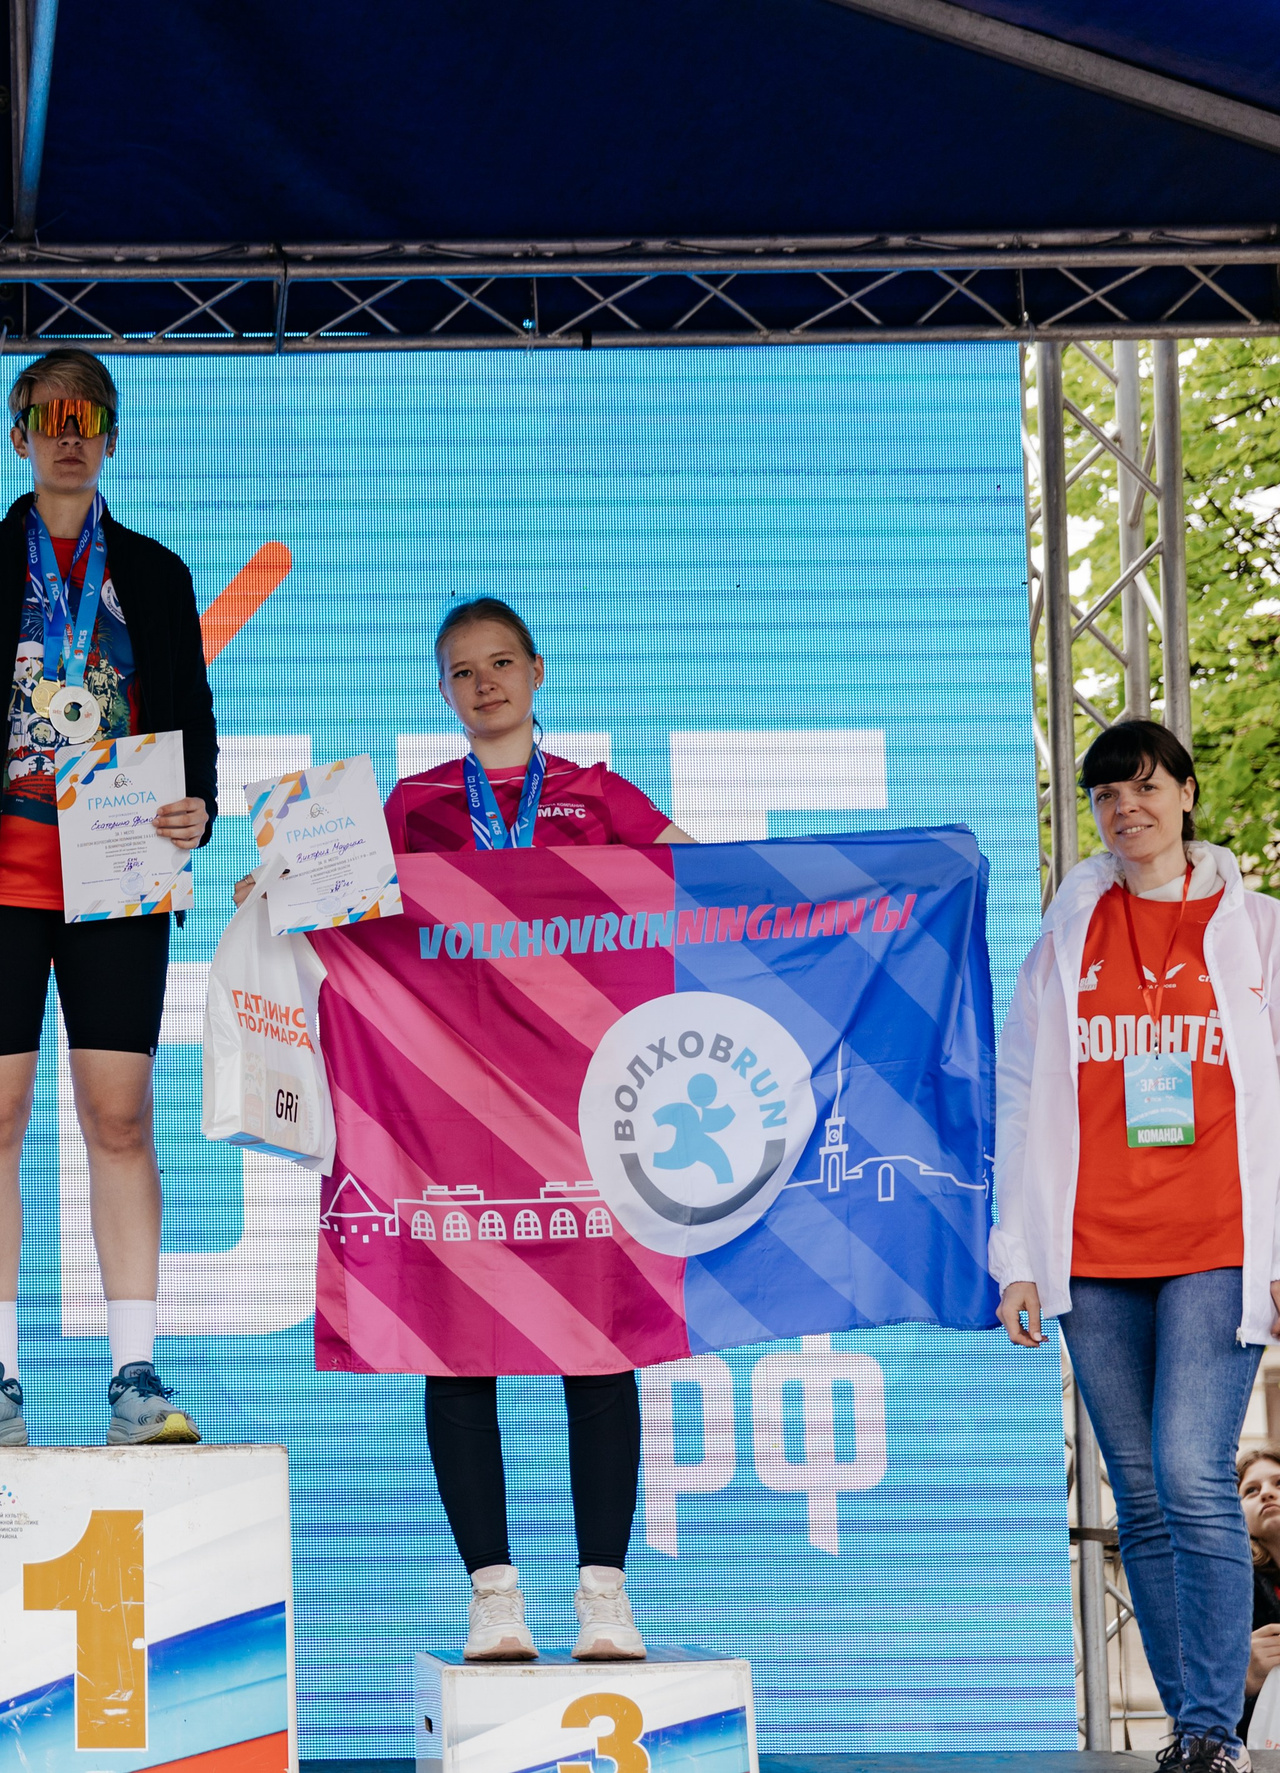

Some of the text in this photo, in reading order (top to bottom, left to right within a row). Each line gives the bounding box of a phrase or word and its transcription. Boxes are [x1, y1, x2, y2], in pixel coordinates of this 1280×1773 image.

[29, 537, 39, 564] СПОРТ
[76, 629, 88, 649] ПСБ
[88, 790, 157, 810] ГРАМОТА
[469, 784, 480, 808] СПОРТ
[537, 807, 586, 819] МАРС
[286, 816, 356, 844] ГРАМОТА
[490, 820, 502, 836] ПСБ
[276, 1088, 299, 1123] GRi
[1137, 1127, 1184, 1143] КОМАНДА
[22, 1509, 147, 1750] 1
[556, 1692, 652, 1773] 3
